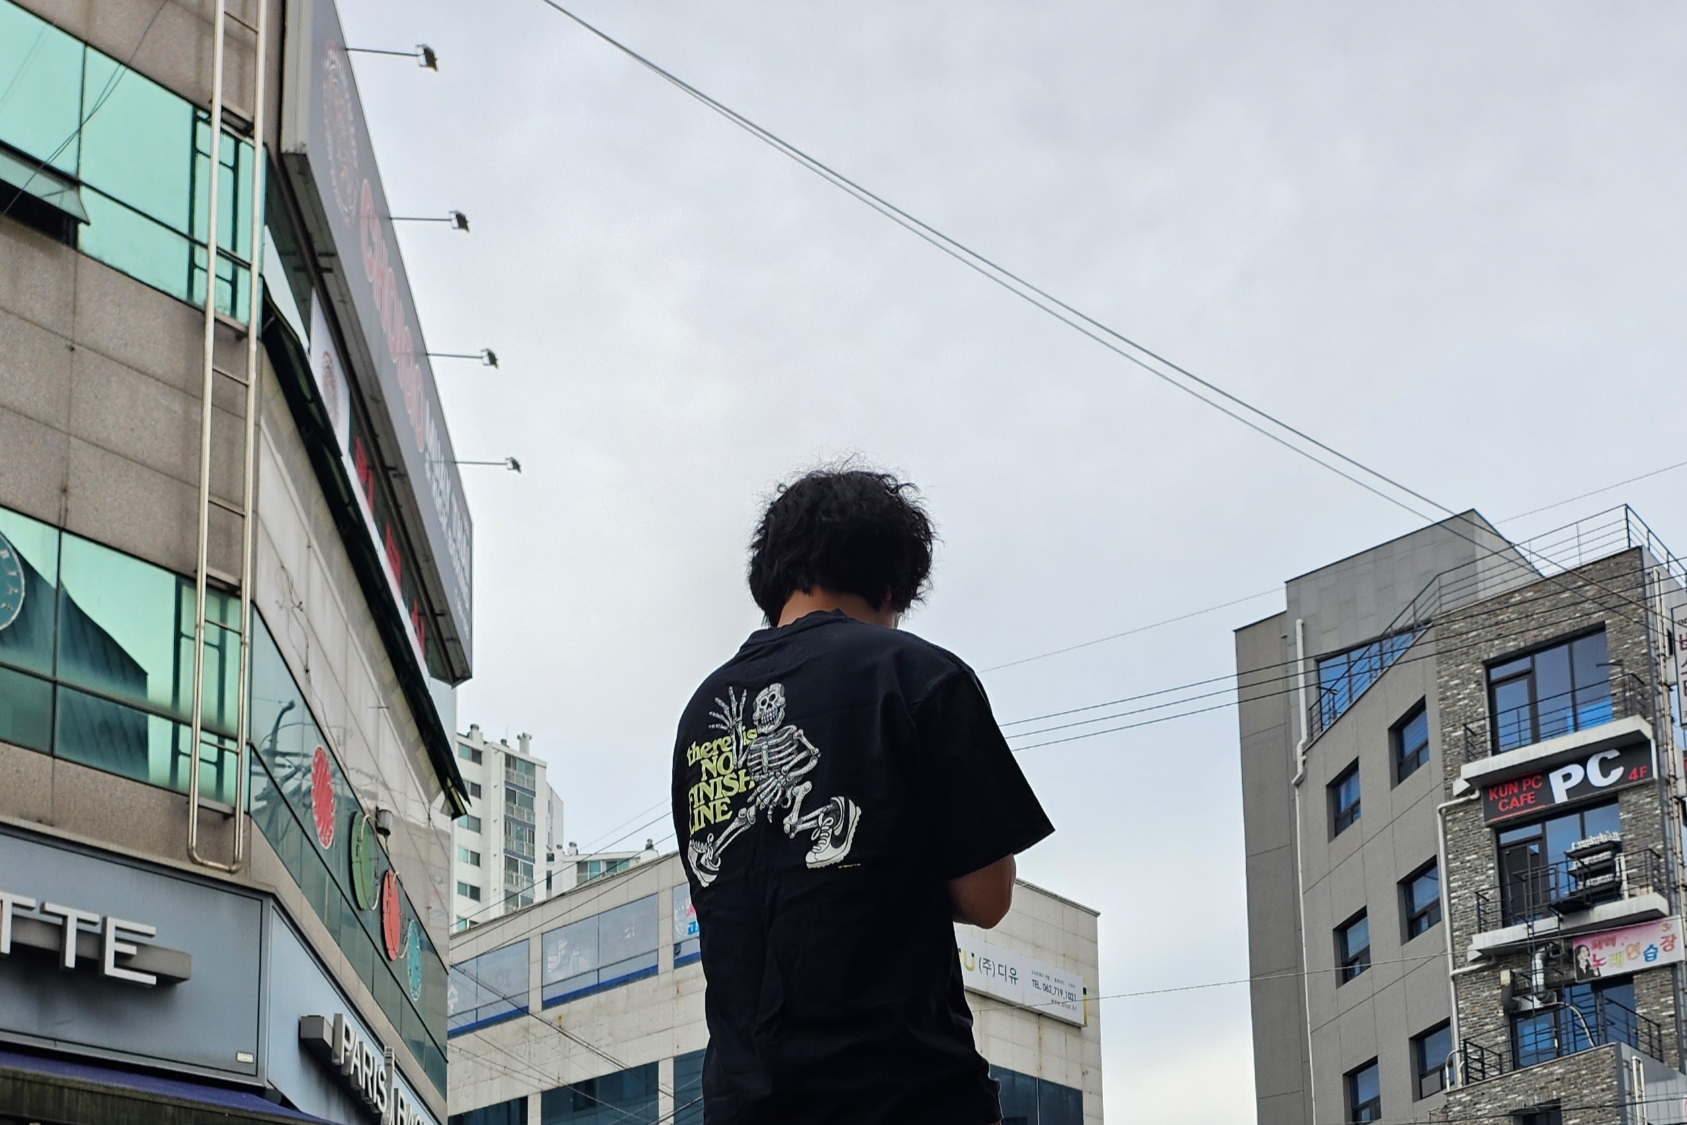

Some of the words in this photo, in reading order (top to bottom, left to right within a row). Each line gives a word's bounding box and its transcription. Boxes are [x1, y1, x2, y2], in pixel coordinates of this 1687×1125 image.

[687, 735, 732, 766] there
[743, 726, 758, 746] is
[700, 751, 734, 781] NO
[1549, 749, 1624, 804] PC
[1628, 766, 1648, 781] 4F
[688, 768, 756, 808] FINISH
[1489, 783, 1519, 801] KUN
[1522, 775, 1543, 791] PC
[1498, 791, 1536, 812] CAFE
[689, 797, 733, 836] LINE
[1592, 934, 1677, 968] 노래연습장
[978, 957, 1019, 985] (주)디유
[333, 1013, 388, 1114] PARIS
